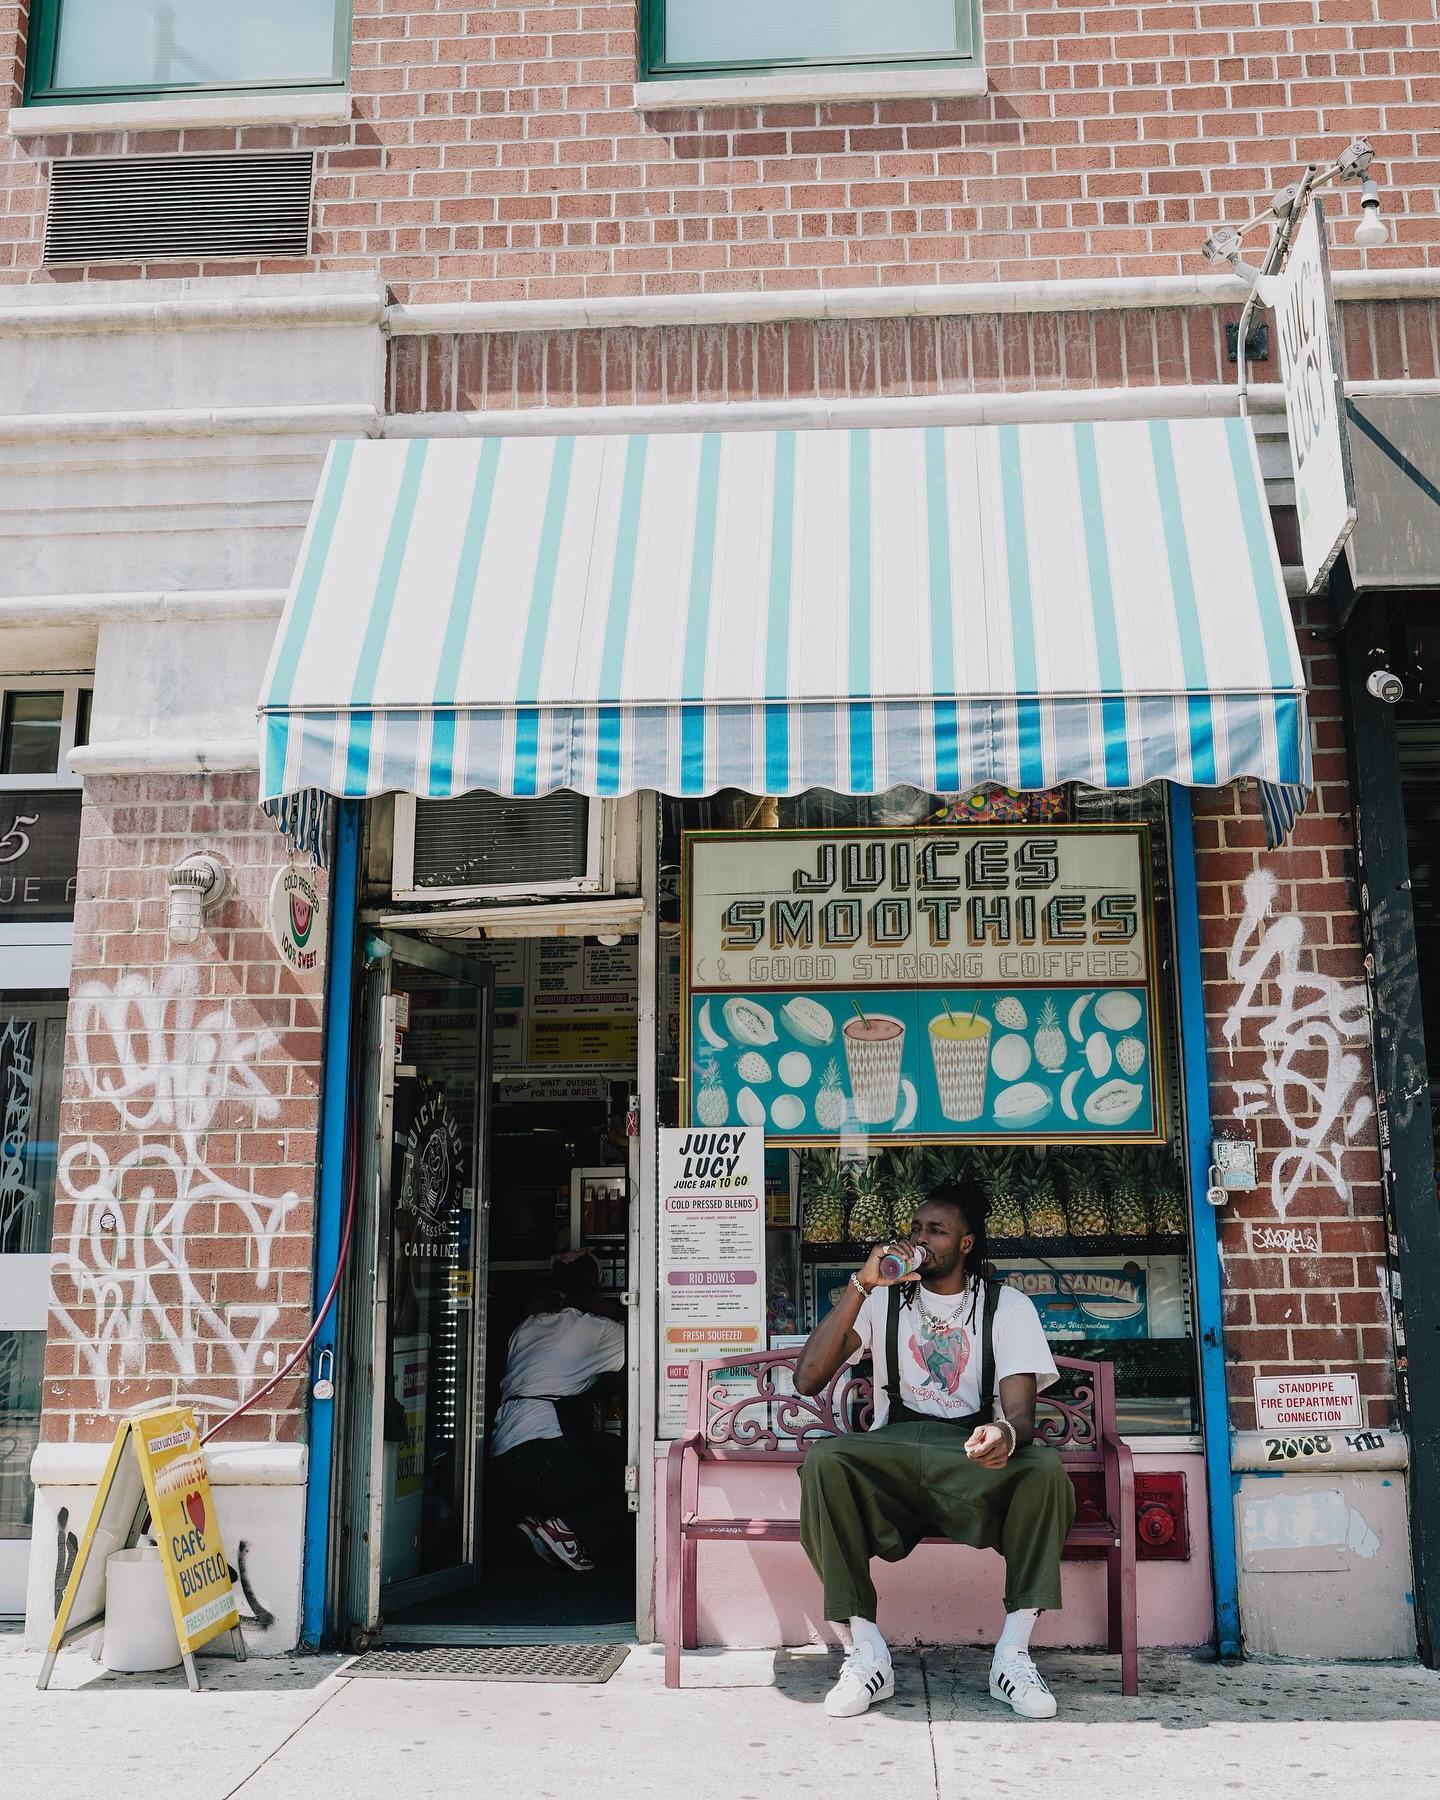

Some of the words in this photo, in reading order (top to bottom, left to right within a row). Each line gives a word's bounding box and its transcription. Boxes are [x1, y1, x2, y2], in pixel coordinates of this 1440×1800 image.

[793, 839, 1059, 894] JUICES
[284, 874, 297, 892] COLD
[298, 876, 320, 914] PRESSED
[720, 893, 1138, 951] SMOOTHIES
[298, 949, 317, 970] SWEET
[748, 956, 836, 982] GOOD
[852, 953, 983, 981] STRONG
[998, 950, 1143, 979] COFFEE)
[540, 1079, 560, 1087] WAIT
[566, 1079, 607, 1087] OUTSIDE
[531, 1089, 545, 1098] FOR
[549, 1089, 567, 1097] YOUR
[571, 1088, 608, 1097] ORDER
[442, 1105, 464, 1174] LUCY
[679, 1132, 747, 1156] JUICY
[683, 1155, 740, 1179] LUCY
[673, 1179, 697, 1190] JUICE
[699, 1179, 717, 1189] BAR
[719, 1177, 731, 1188] TO
[734, 1175, 748, 1187] GO
[671, 1200, 690, 1210] COLD
[692, 1199, 723, 1210] PRESSED
[725, 1198, 753, 1209] BLENDS
[417, 1216, 448, 1238] PRESSED
[404, 1242, 460, 1258] CATERING
[689, 1272, 704, 1284] RIO
[706, 1272, 736, 1284] BOWLS
[682, 1330, 705, 1341] FRESH
[707, 1330, 742, 1341] SQUEEZED
[669, 1367, 683, 1377] HOT
[729, 1366, 750, 1377] DRIN
[1278, 1381, 1334, 1394] STANDPIPE
[1261, 1398, 1283, 1409] FIRE
[1286, 1395, 1353, 1408] DEPARTMENT
[1277, 1411, 1341, 1423] CONNECTION
[149, 1439, 162, 1453] JUICY
[162, 1437, 173, 1449] LUCY
[182, 1430, 192, 1443] BAR
[181, 1500, 189, 1525] I
[186, 1614, 205, 1634] FRESH
[205, 1605, 220, 1622] COLD
[219, 1594, 236, 1614] BREW
